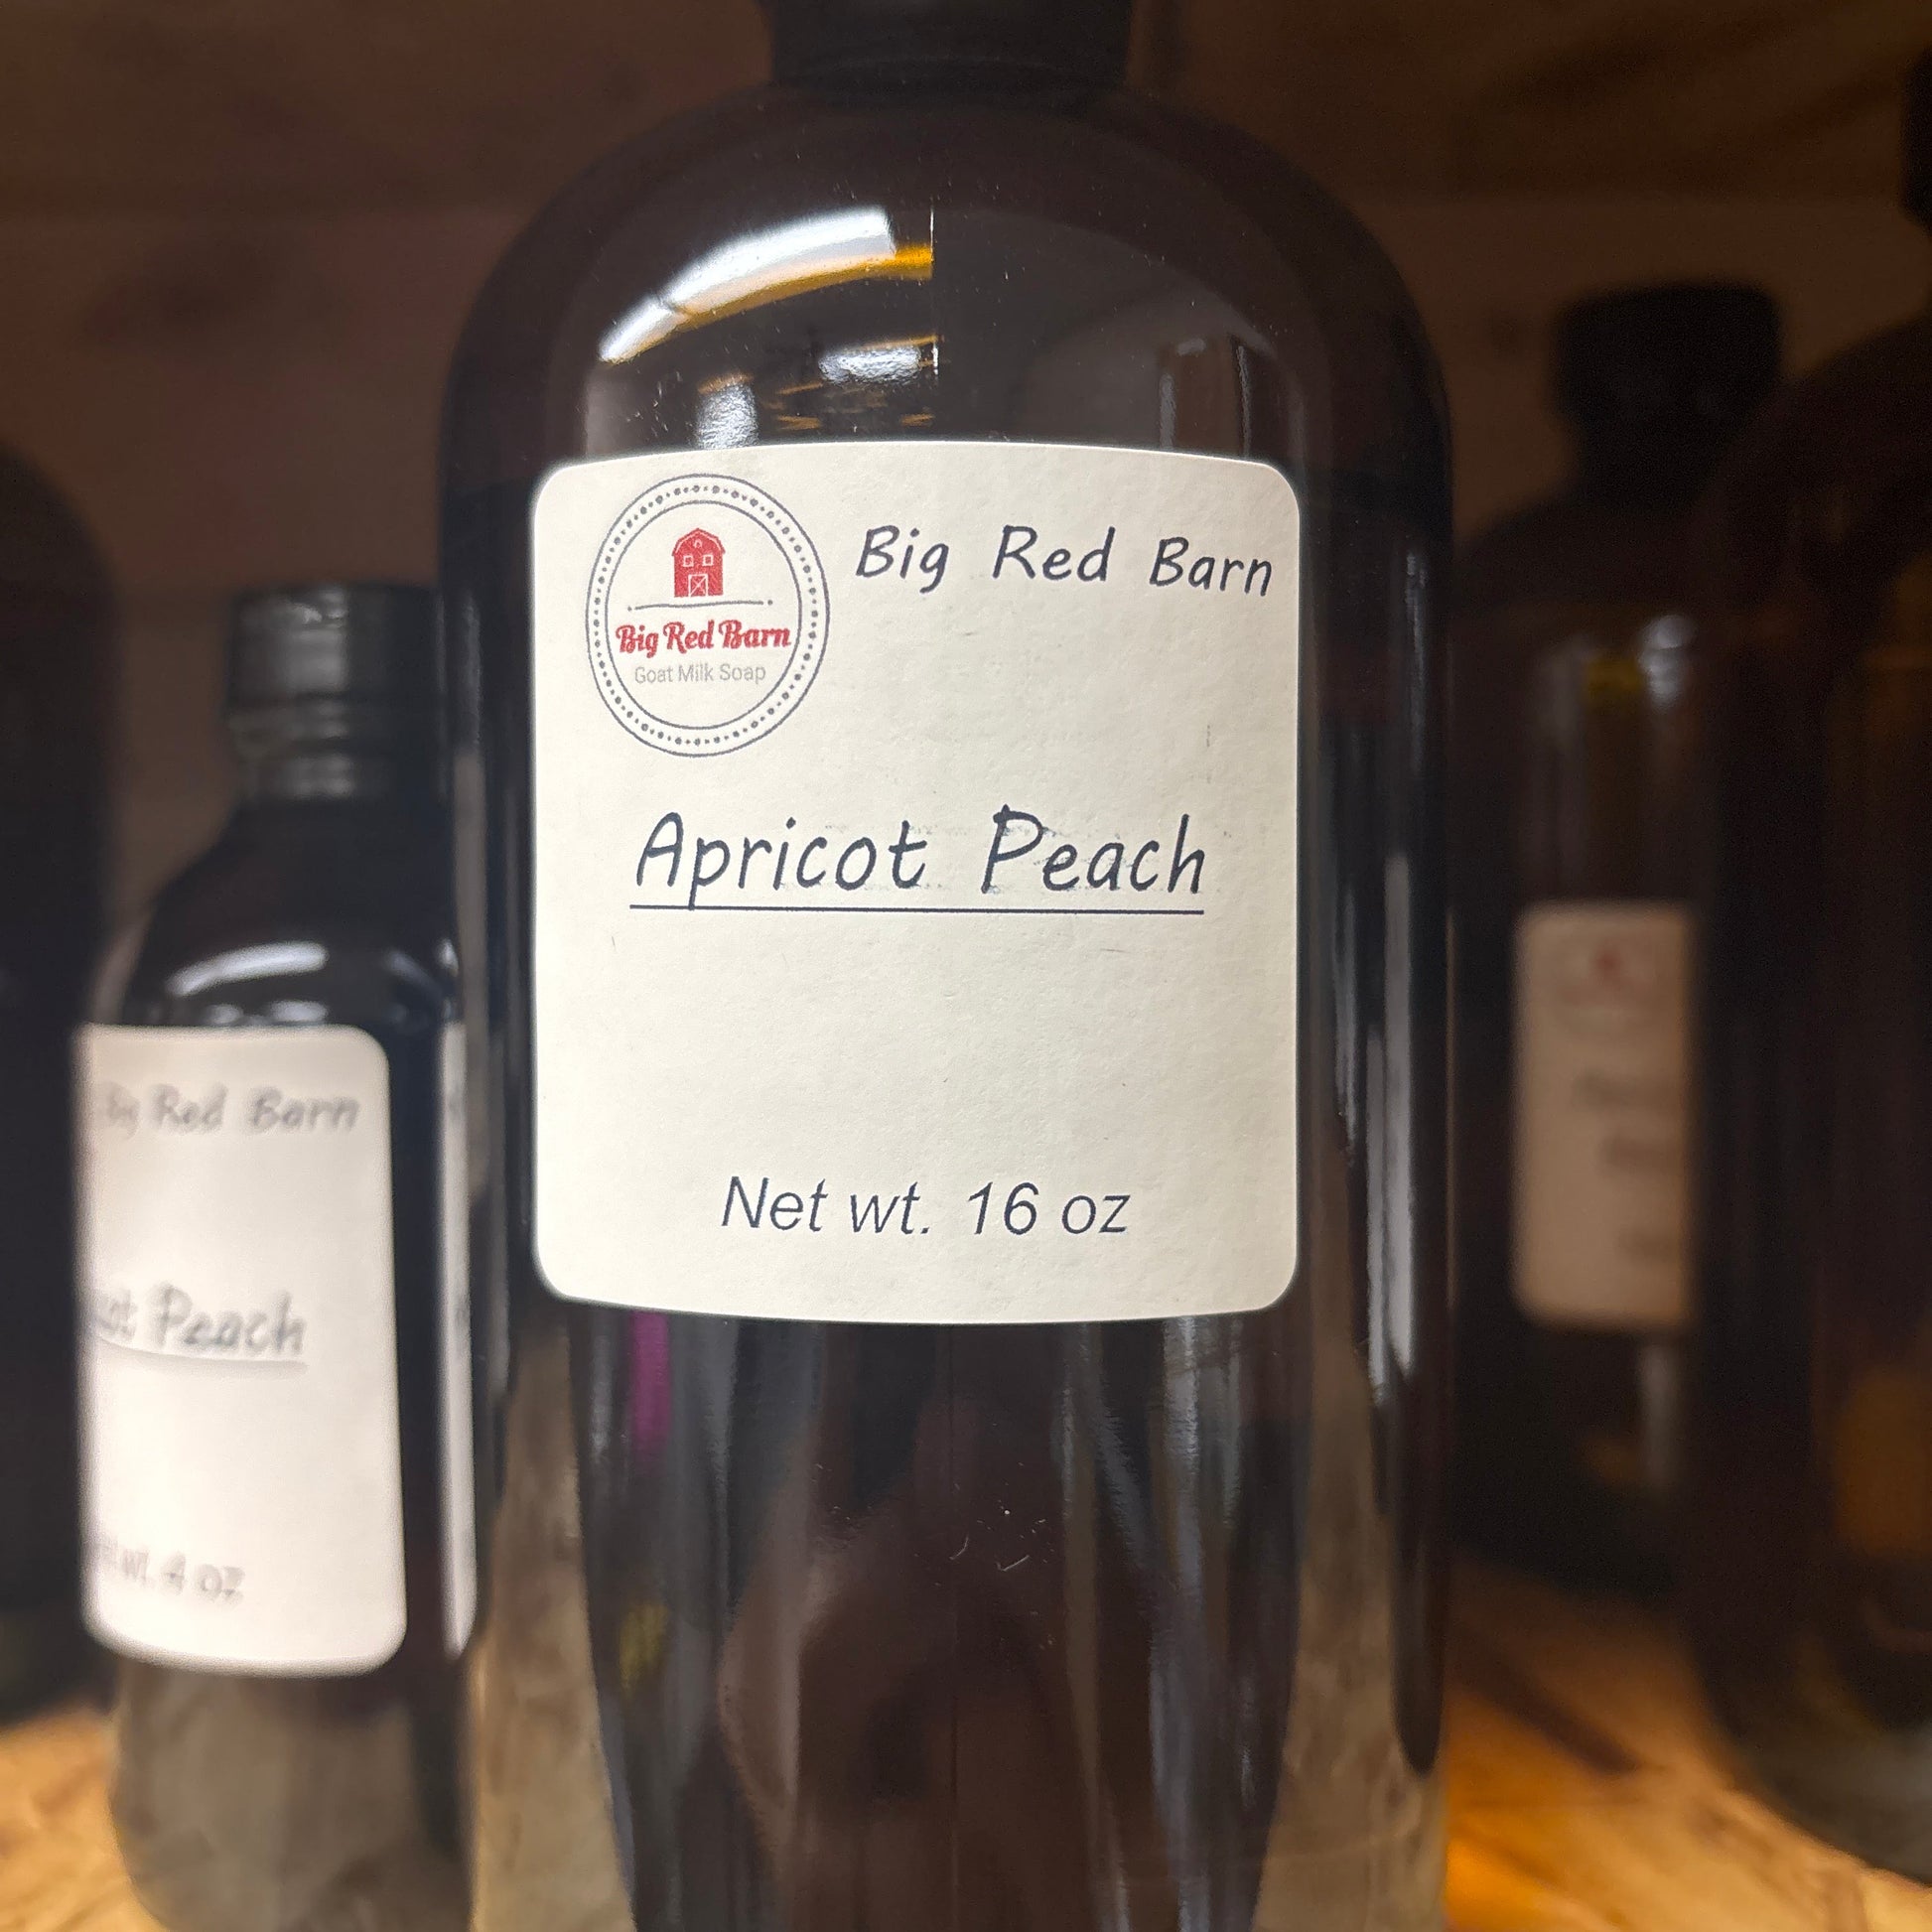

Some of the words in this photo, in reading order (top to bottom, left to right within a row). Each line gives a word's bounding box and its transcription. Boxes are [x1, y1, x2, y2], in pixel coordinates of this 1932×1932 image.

[857, 525, 950, 594] Big
[993, 525, 1116, 583] Red
[1149, 536, 1274, 599] Barn
[615, 624, 659, 659] Big
[662, 619, 715, 654] Red
[718, 619, 791, 648] Barn
[633, 666, 674, 684] Goat
[677, 663, 714, 683] Milk
[719, 662, 766, 685] Soap
[634, 810, 928, 910] Apricot
[979, 803, 1205, 896] Peach
[249, 1084, 359, 1134] Barn
[721, 1175, 829, 1232] Net
[850, 1180, 930, 1235] wt.
[967, 1180, 1040, 1235] 16
[1061, 1193, 1132, 1234] oz
[151, 1281, 307, 1354] Peach
